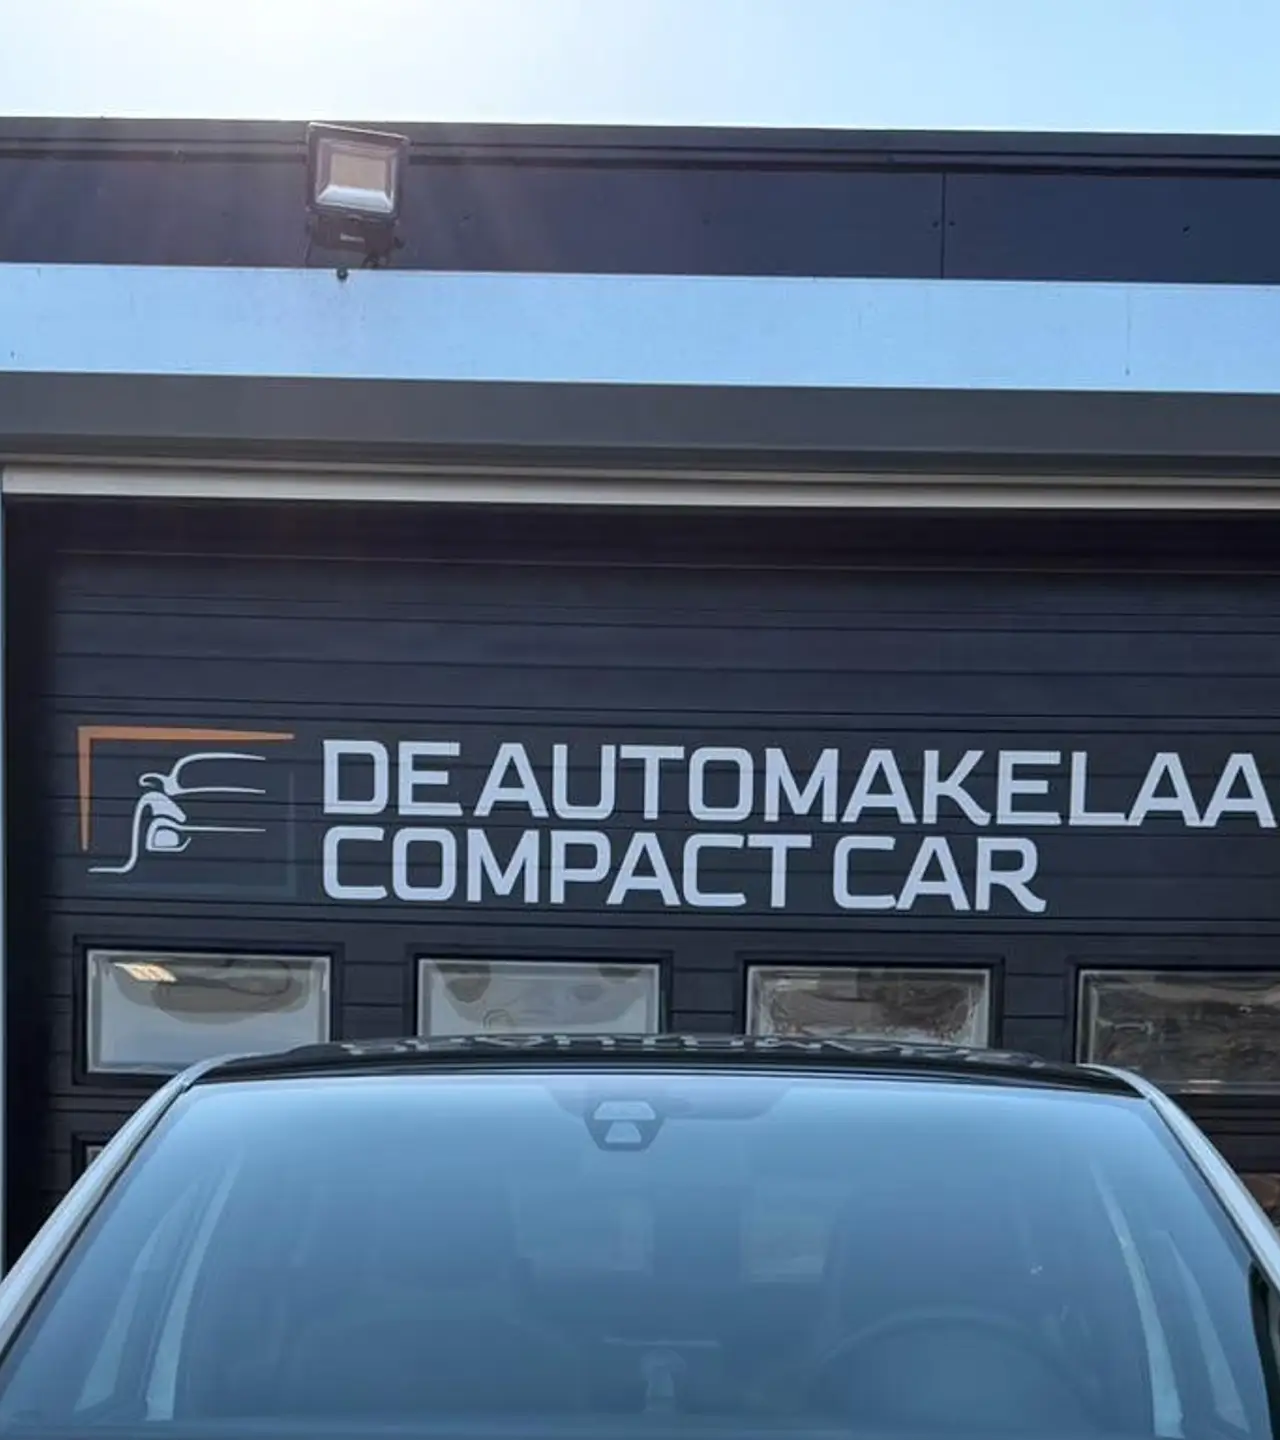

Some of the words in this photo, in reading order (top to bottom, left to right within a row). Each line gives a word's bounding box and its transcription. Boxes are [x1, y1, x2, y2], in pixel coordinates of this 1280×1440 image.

[323, 739, 463, 817] DE
[323, 827, 812, 908] COMPACT
[832, 835, 1047, 913] CAR
